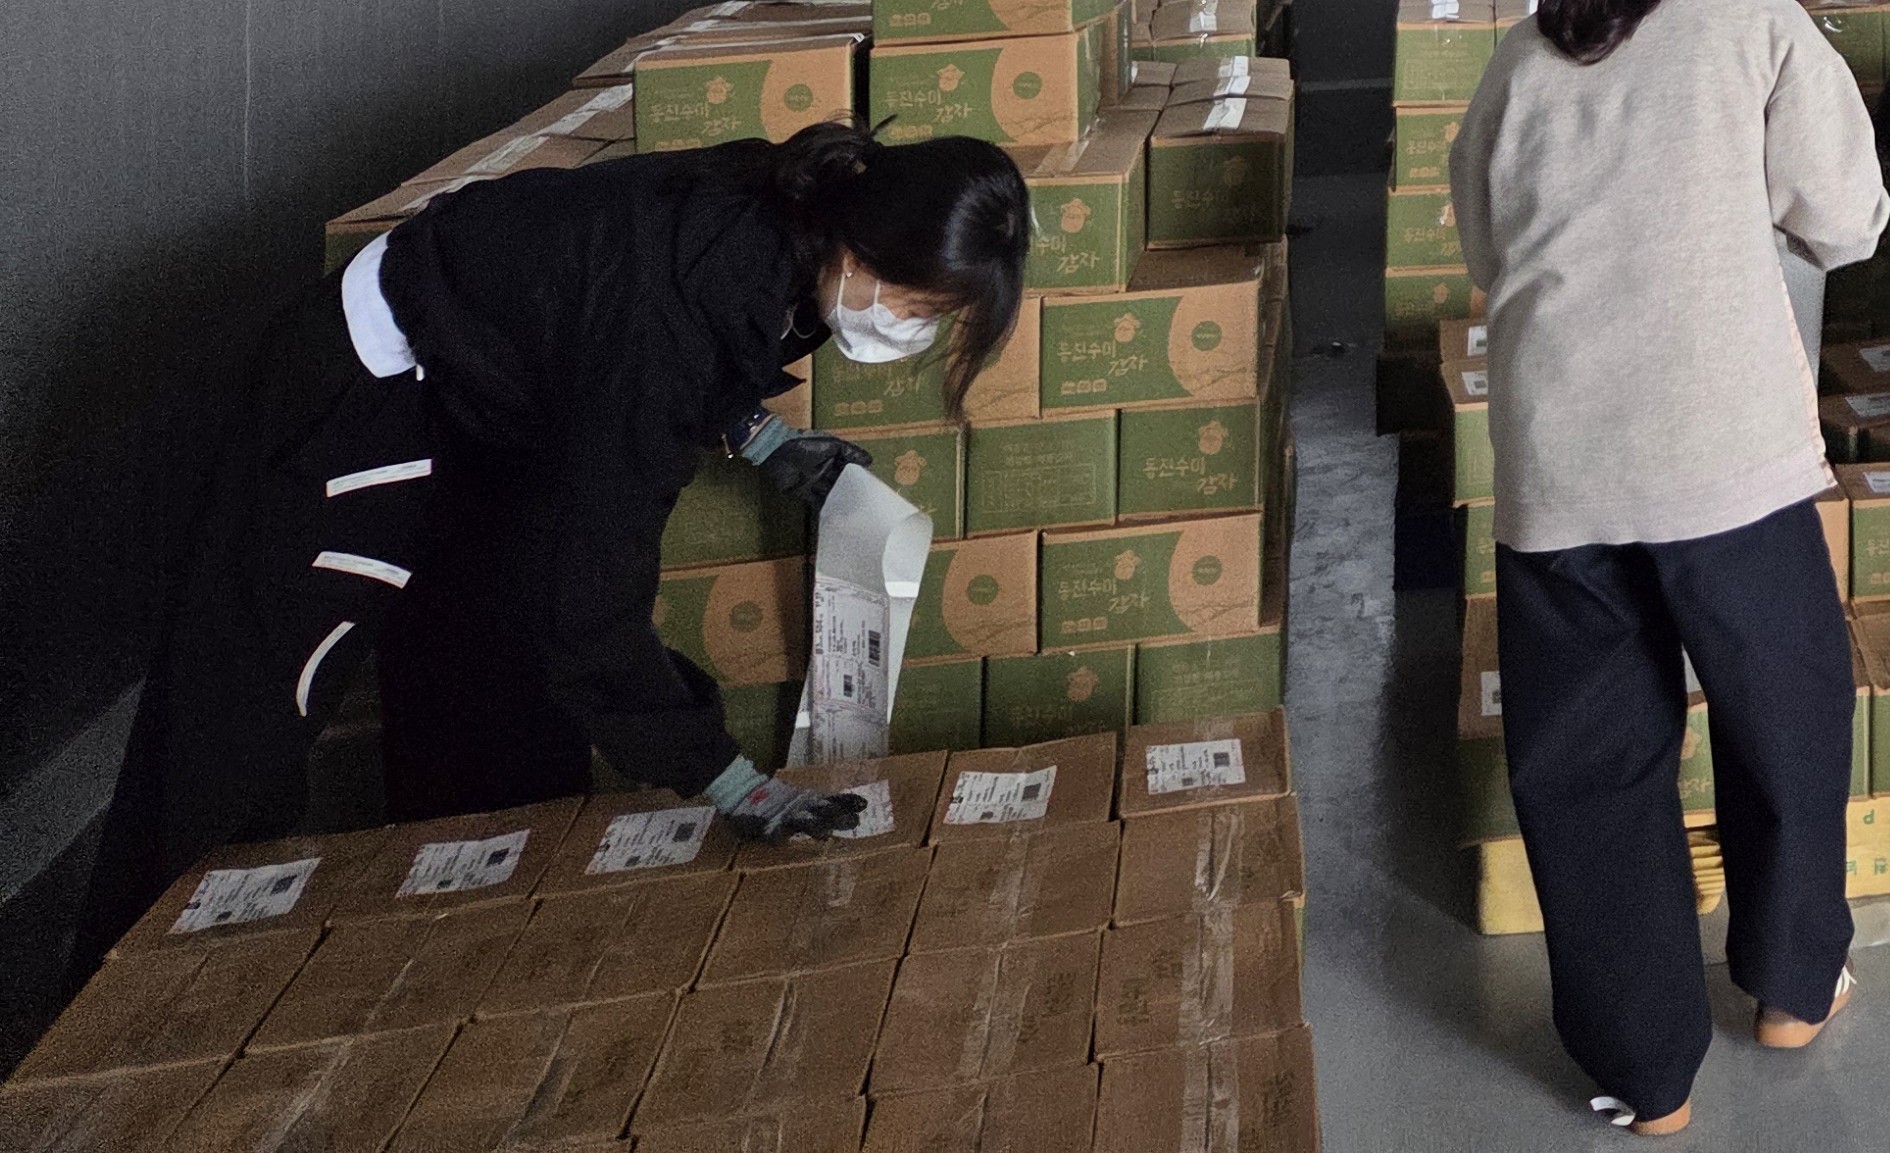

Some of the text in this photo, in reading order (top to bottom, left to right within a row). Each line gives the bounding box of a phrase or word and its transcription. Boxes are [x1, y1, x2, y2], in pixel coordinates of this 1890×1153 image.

[885, 89, 942, 109] 동진수미
[933, 102, 973, 124] 감자
[701, 115, 742, 137] 감자
[1057, 251, 1101, 275] 감자
[1057, 339, 1117, 364] 동진수미
[1108, 353, 1149, 377] 감자
[1142, 455, 1207, 480] 동진수미
[1197, 471, 1238, 496] 감자
[1058, 578, 1118, 601] 동진수미
[1108, 591, 1150, 615] 감자
